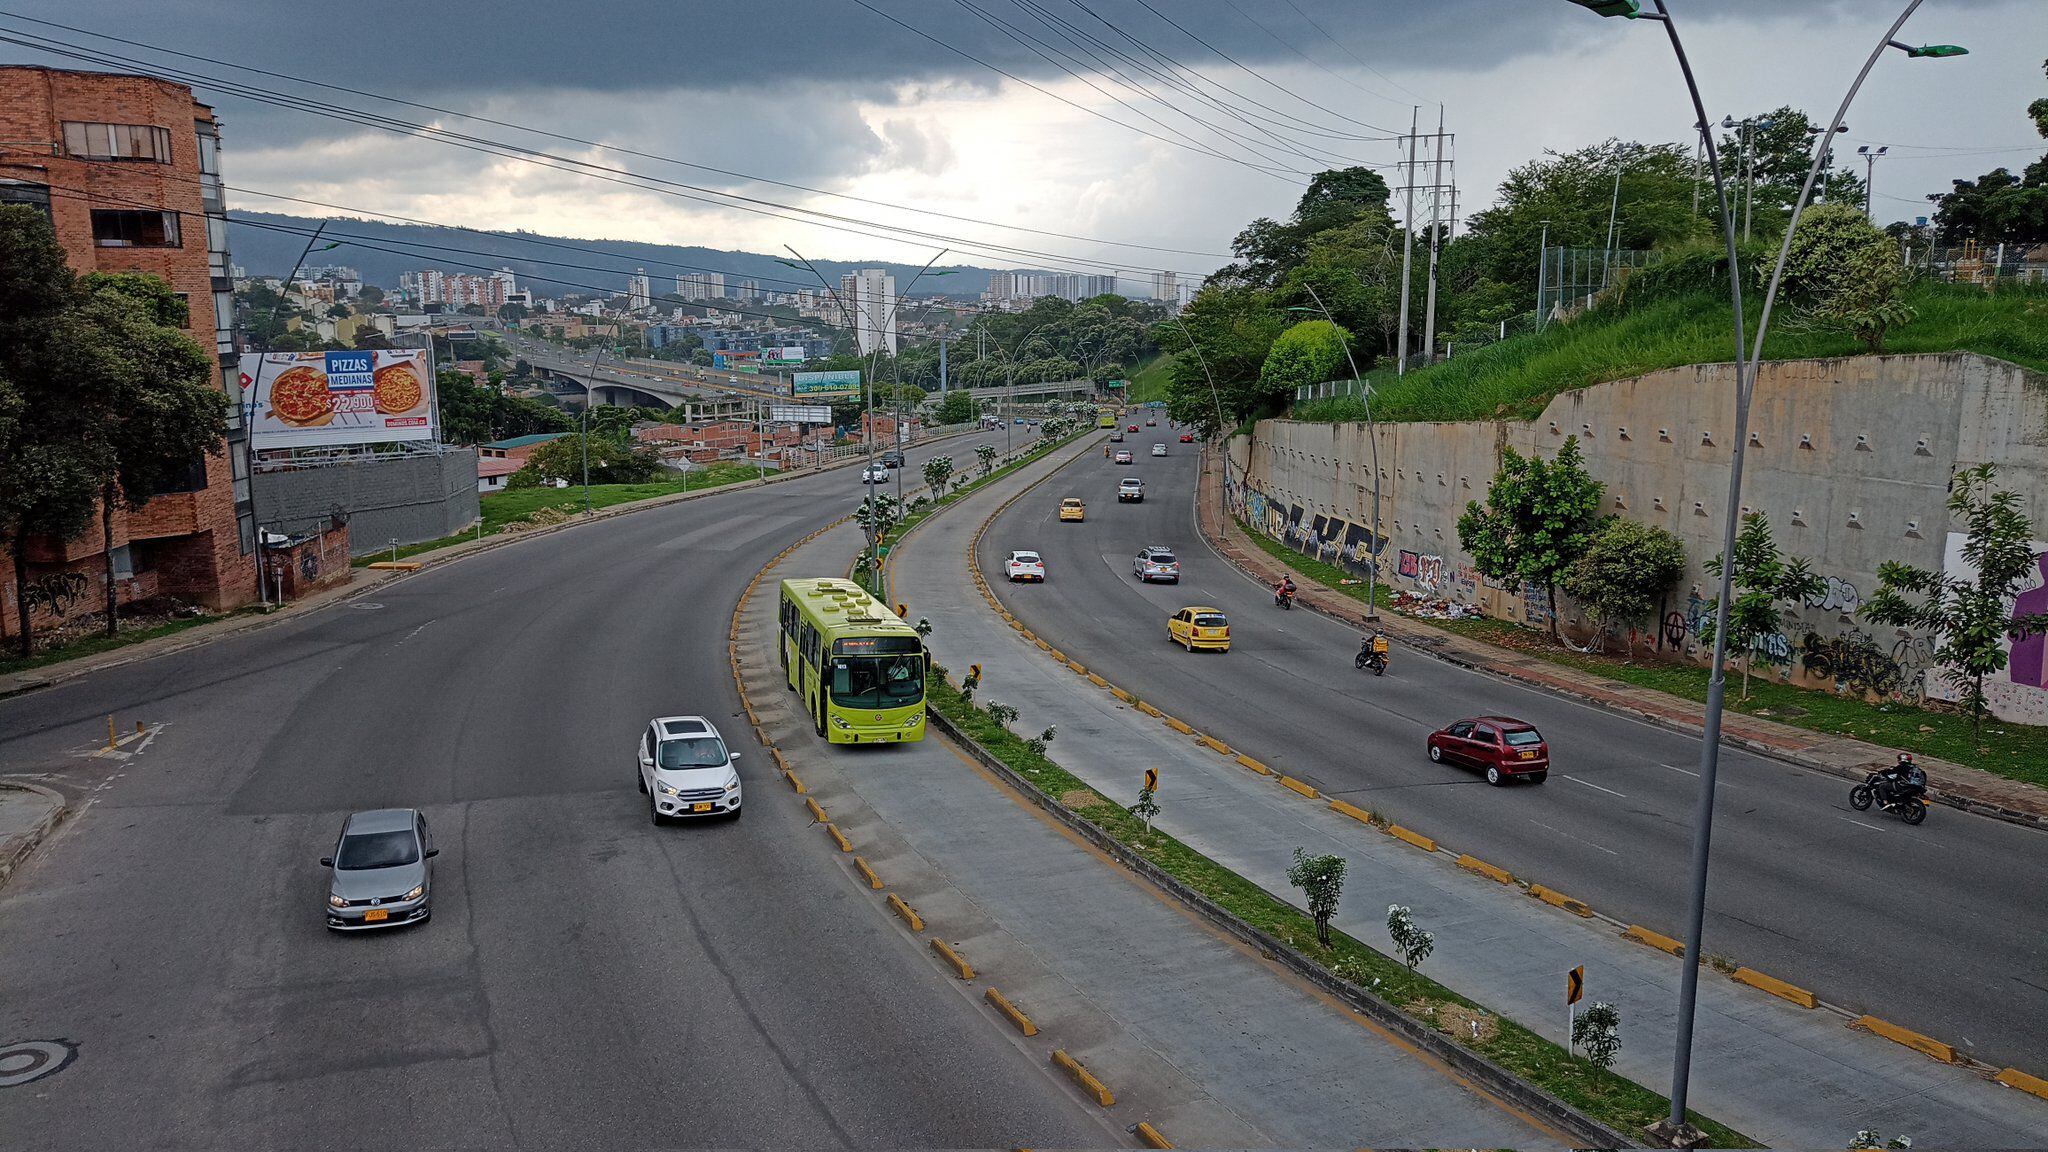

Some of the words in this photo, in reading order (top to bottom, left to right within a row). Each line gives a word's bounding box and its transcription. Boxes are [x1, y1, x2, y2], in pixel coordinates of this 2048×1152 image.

[331, 359, 368, 372] PIZZAS
[331, 374, 372, 385] MEDIANAS
[798, 372, 856, 381] DISPONIBLE
